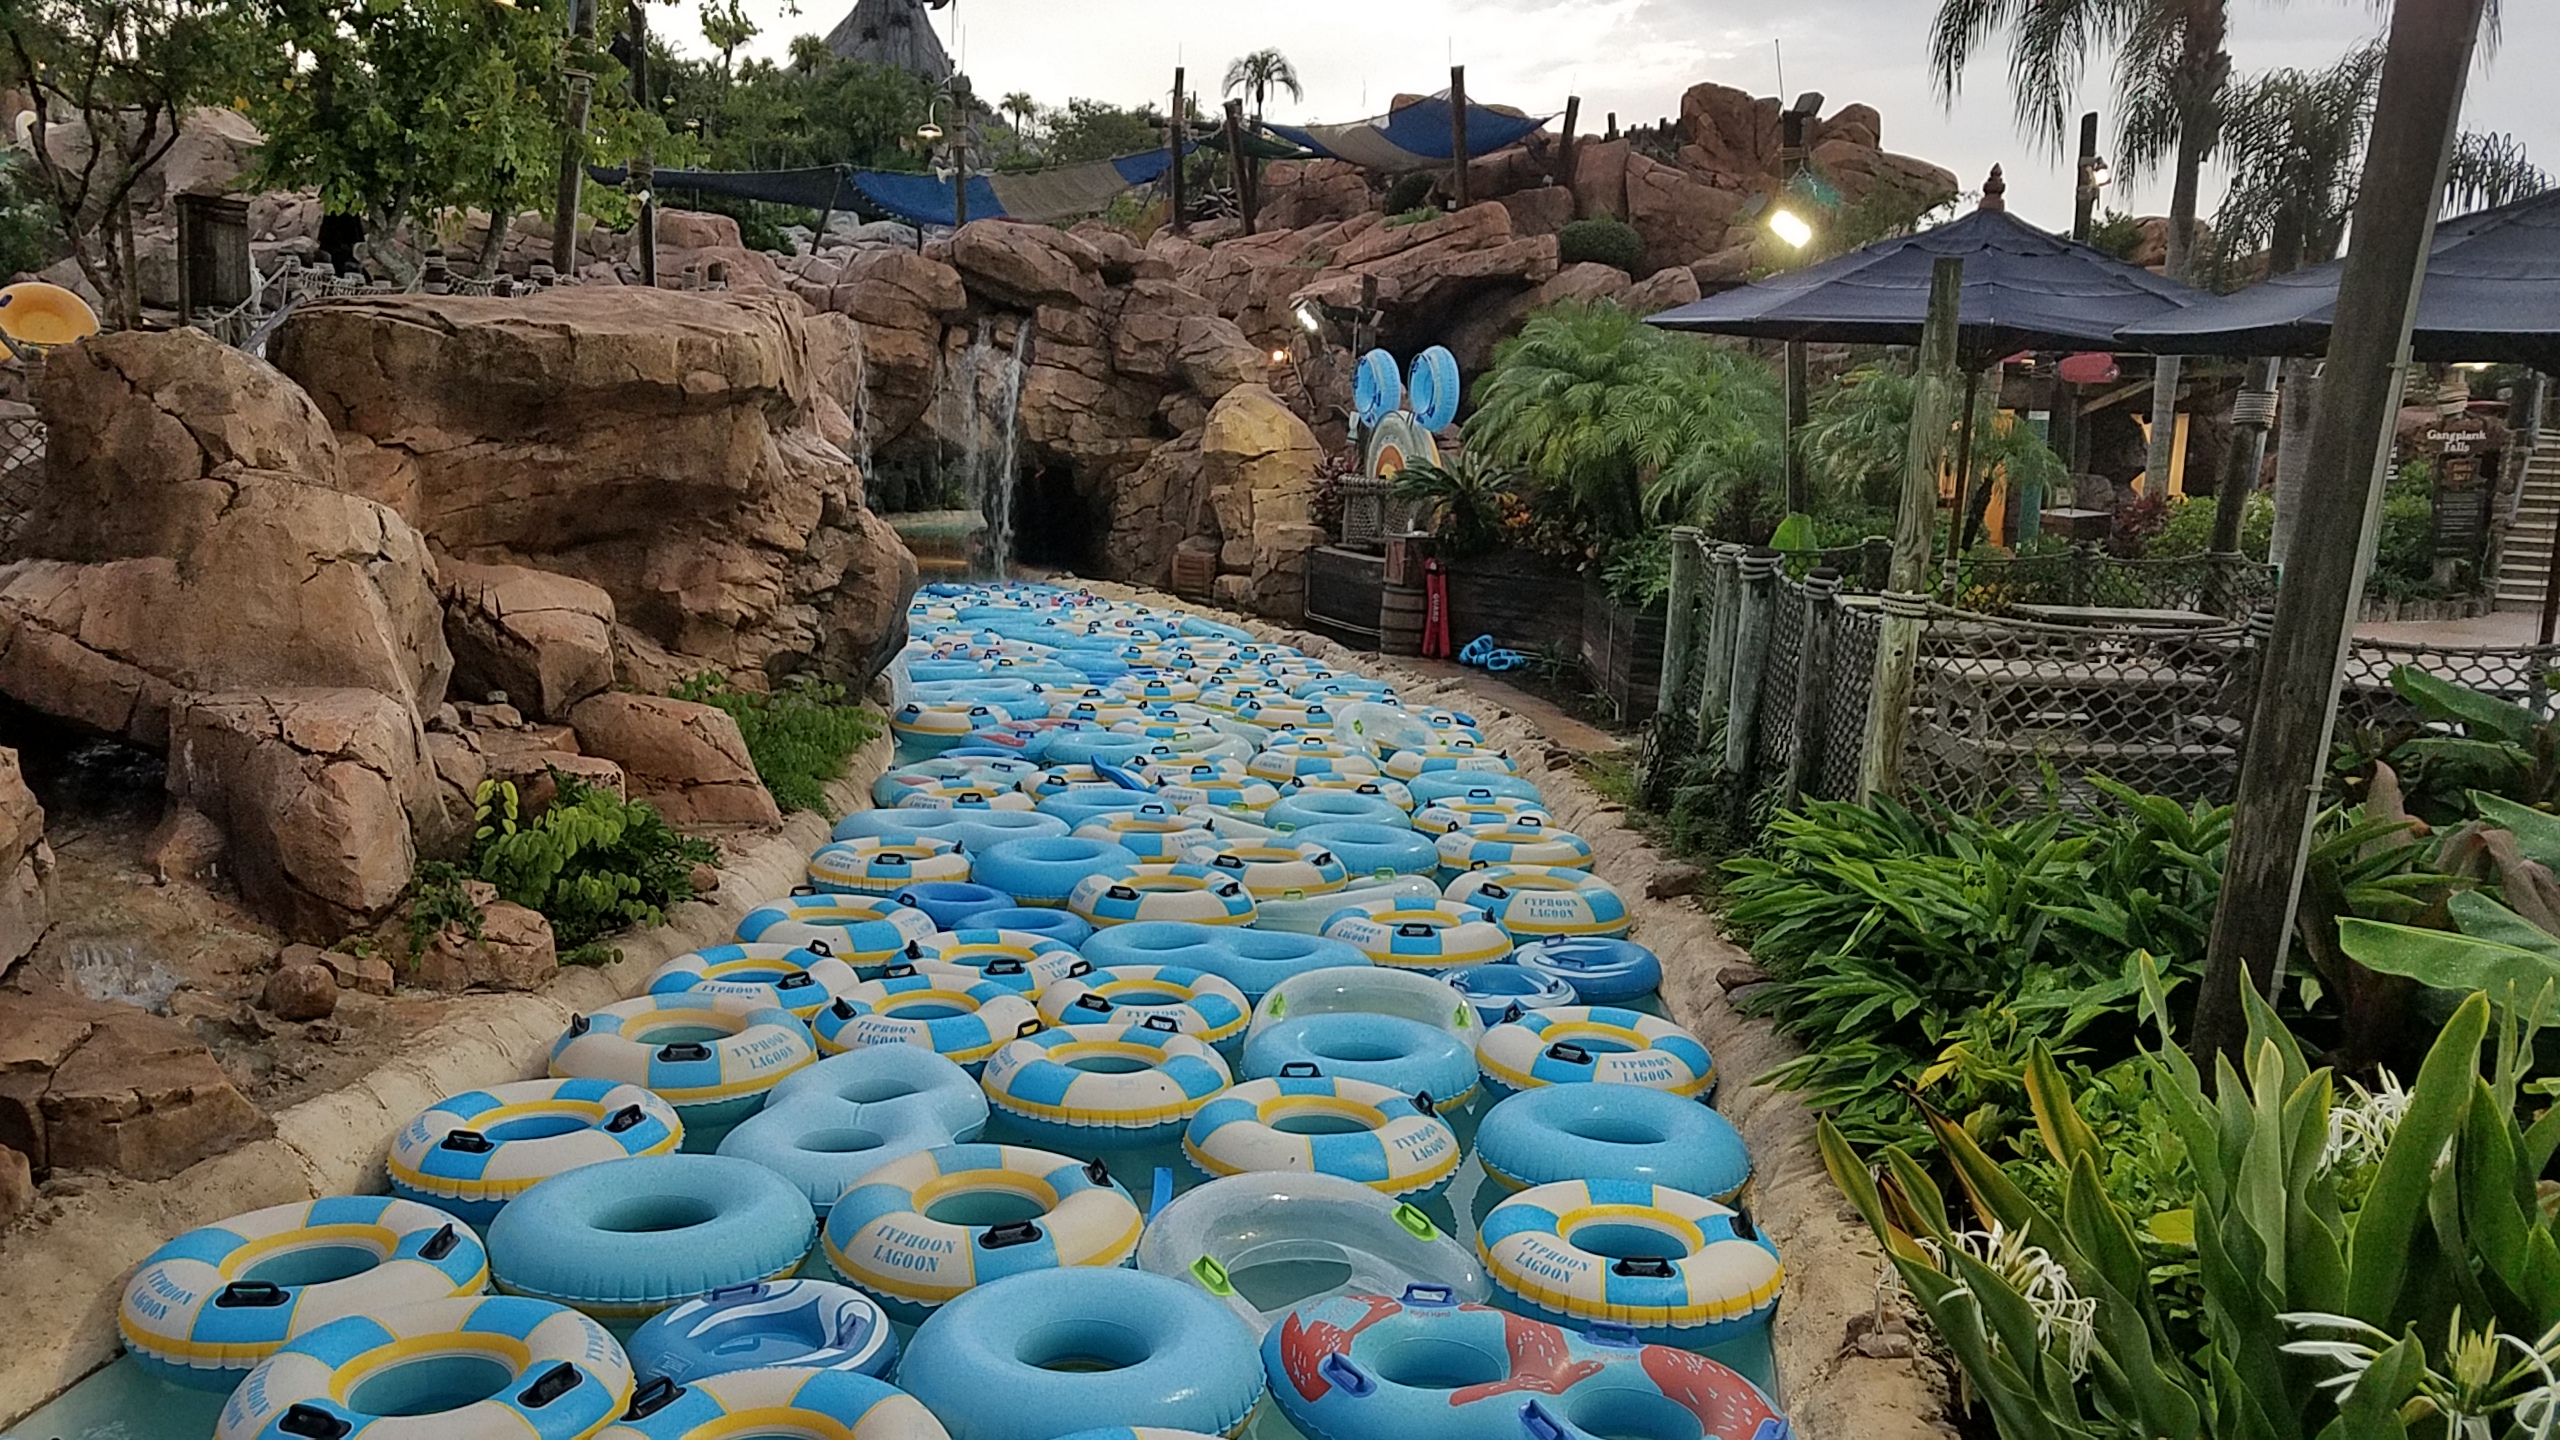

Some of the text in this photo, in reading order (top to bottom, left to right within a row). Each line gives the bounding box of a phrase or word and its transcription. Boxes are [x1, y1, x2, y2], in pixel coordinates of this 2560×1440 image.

[2426, 429, 2487, 442] Gangplank
[2443, 441, 2470, 452] Falls
[1432, 593, 1440, 623] GUARD
[1524, 898, 1578, 907] TYPHOON
[1530, 907, 1574, 919] LAGOON
[701, 984, 762, 994] TYPHOON
[858, 1020, 917, 1034] TYPHOON
[731, 1032, 791, 1057] TYPHOON
[857, 1032, 907, 1045] LAGOON
[749, 1046, 795, 1069] LAGOON
[1611, 1056, 1673, 1069] TYPHOON
[1623, 1069, 1673, 1083] LAGOON
[877, 1225, 956, 1254] TYPHOON
[873, 1244, 939, 1273] LAGOON
[1522, 1237, 1592, 1272] TYPHOON
[1515, 1251, 1574, 1283] LAGOON
[147, 1268, 197, 1305] TYPHOON
[131, 1285, 170, 1320] LAGOON
